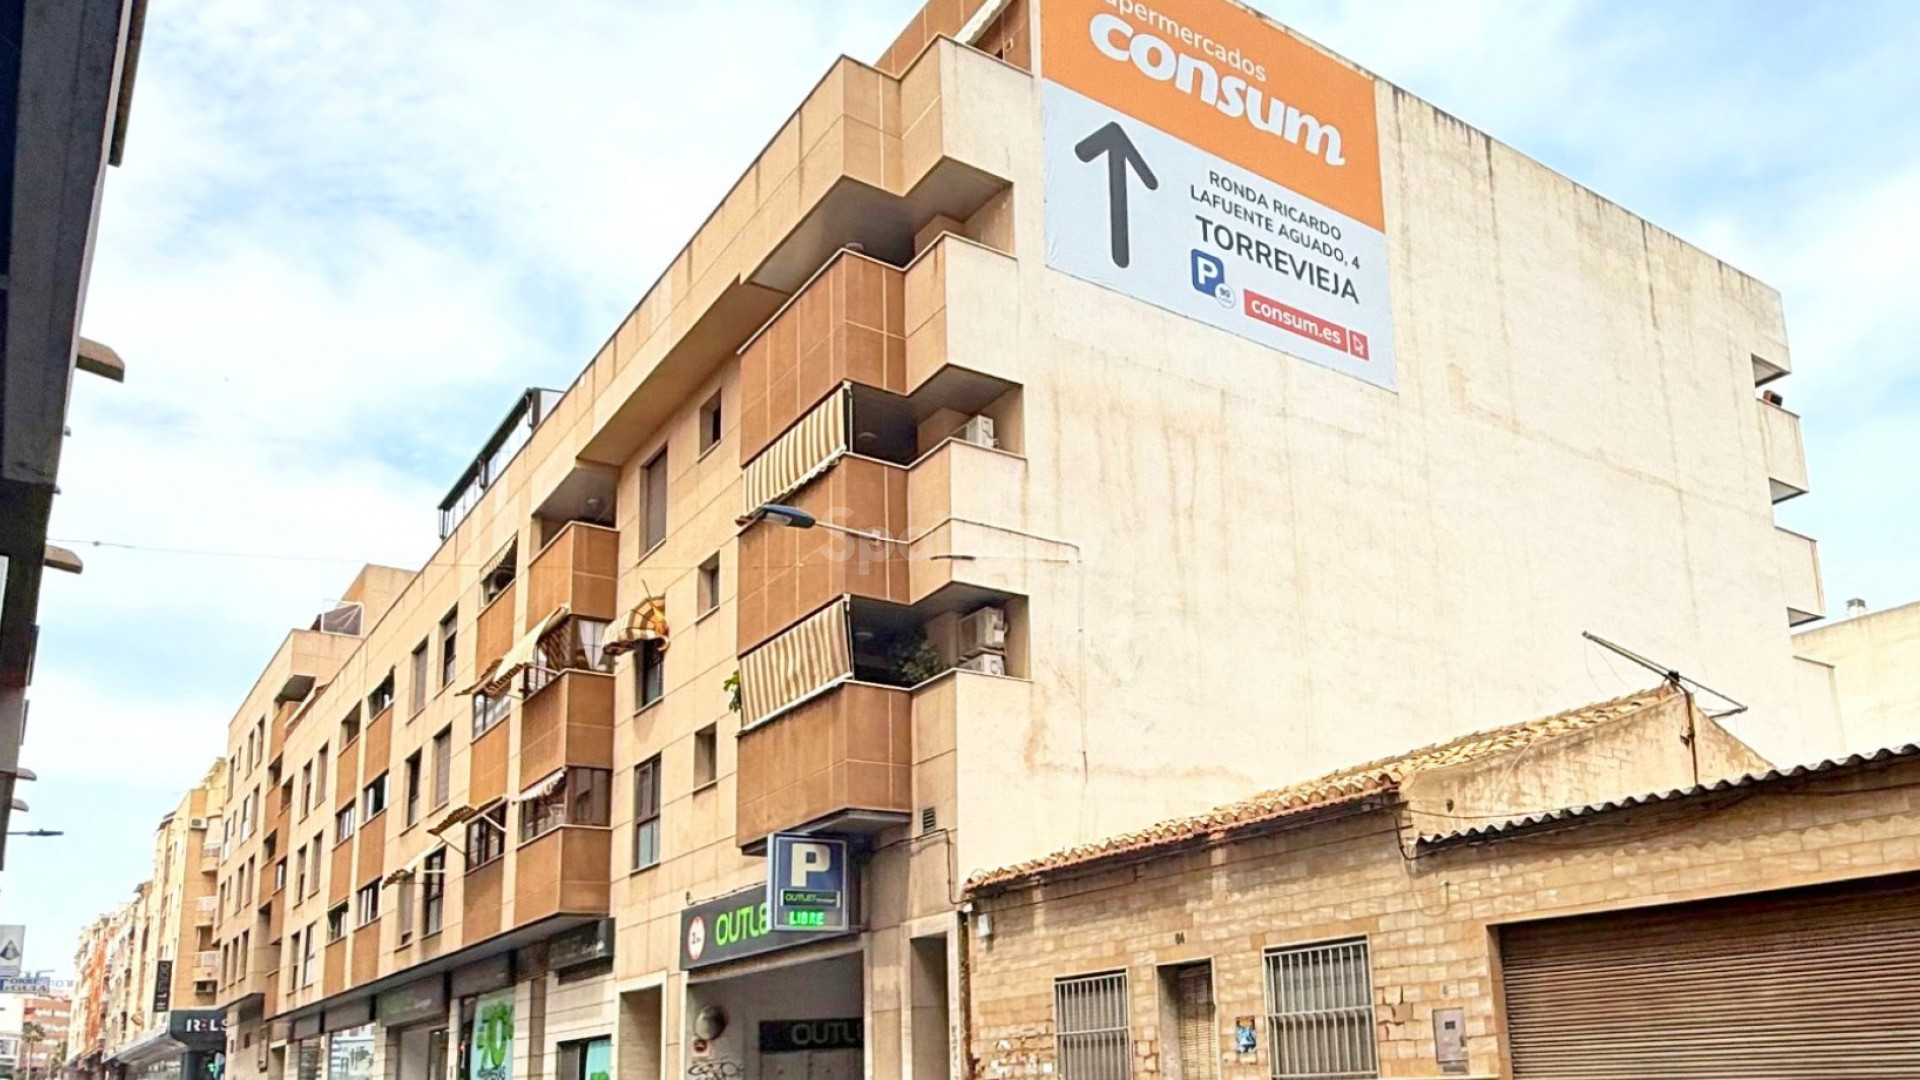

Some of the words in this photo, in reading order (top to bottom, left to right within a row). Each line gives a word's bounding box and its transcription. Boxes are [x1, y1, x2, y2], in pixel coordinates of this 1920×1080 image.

[1089, 12, 1346, 166] consum
[1190, 184, 1275, 233] LAFUENTE
[1278, 223, 1349, 266] AGUADO,
[1351, 255, 1361, 270] 4
[1209, 170, 1269, 209] RONDA
[1273, 199, 1342, 241] RICARDO
[1195, 214, 1360, 304] TORREVIEJA
[1196, 255, 1219, 285] P
[1250, 299, 1342, 345] consum.es
[791, 842, 831, 887] P
[789, 911, 826, 926] LIBRE
[792, 1022, 863, 1045] OUTL
